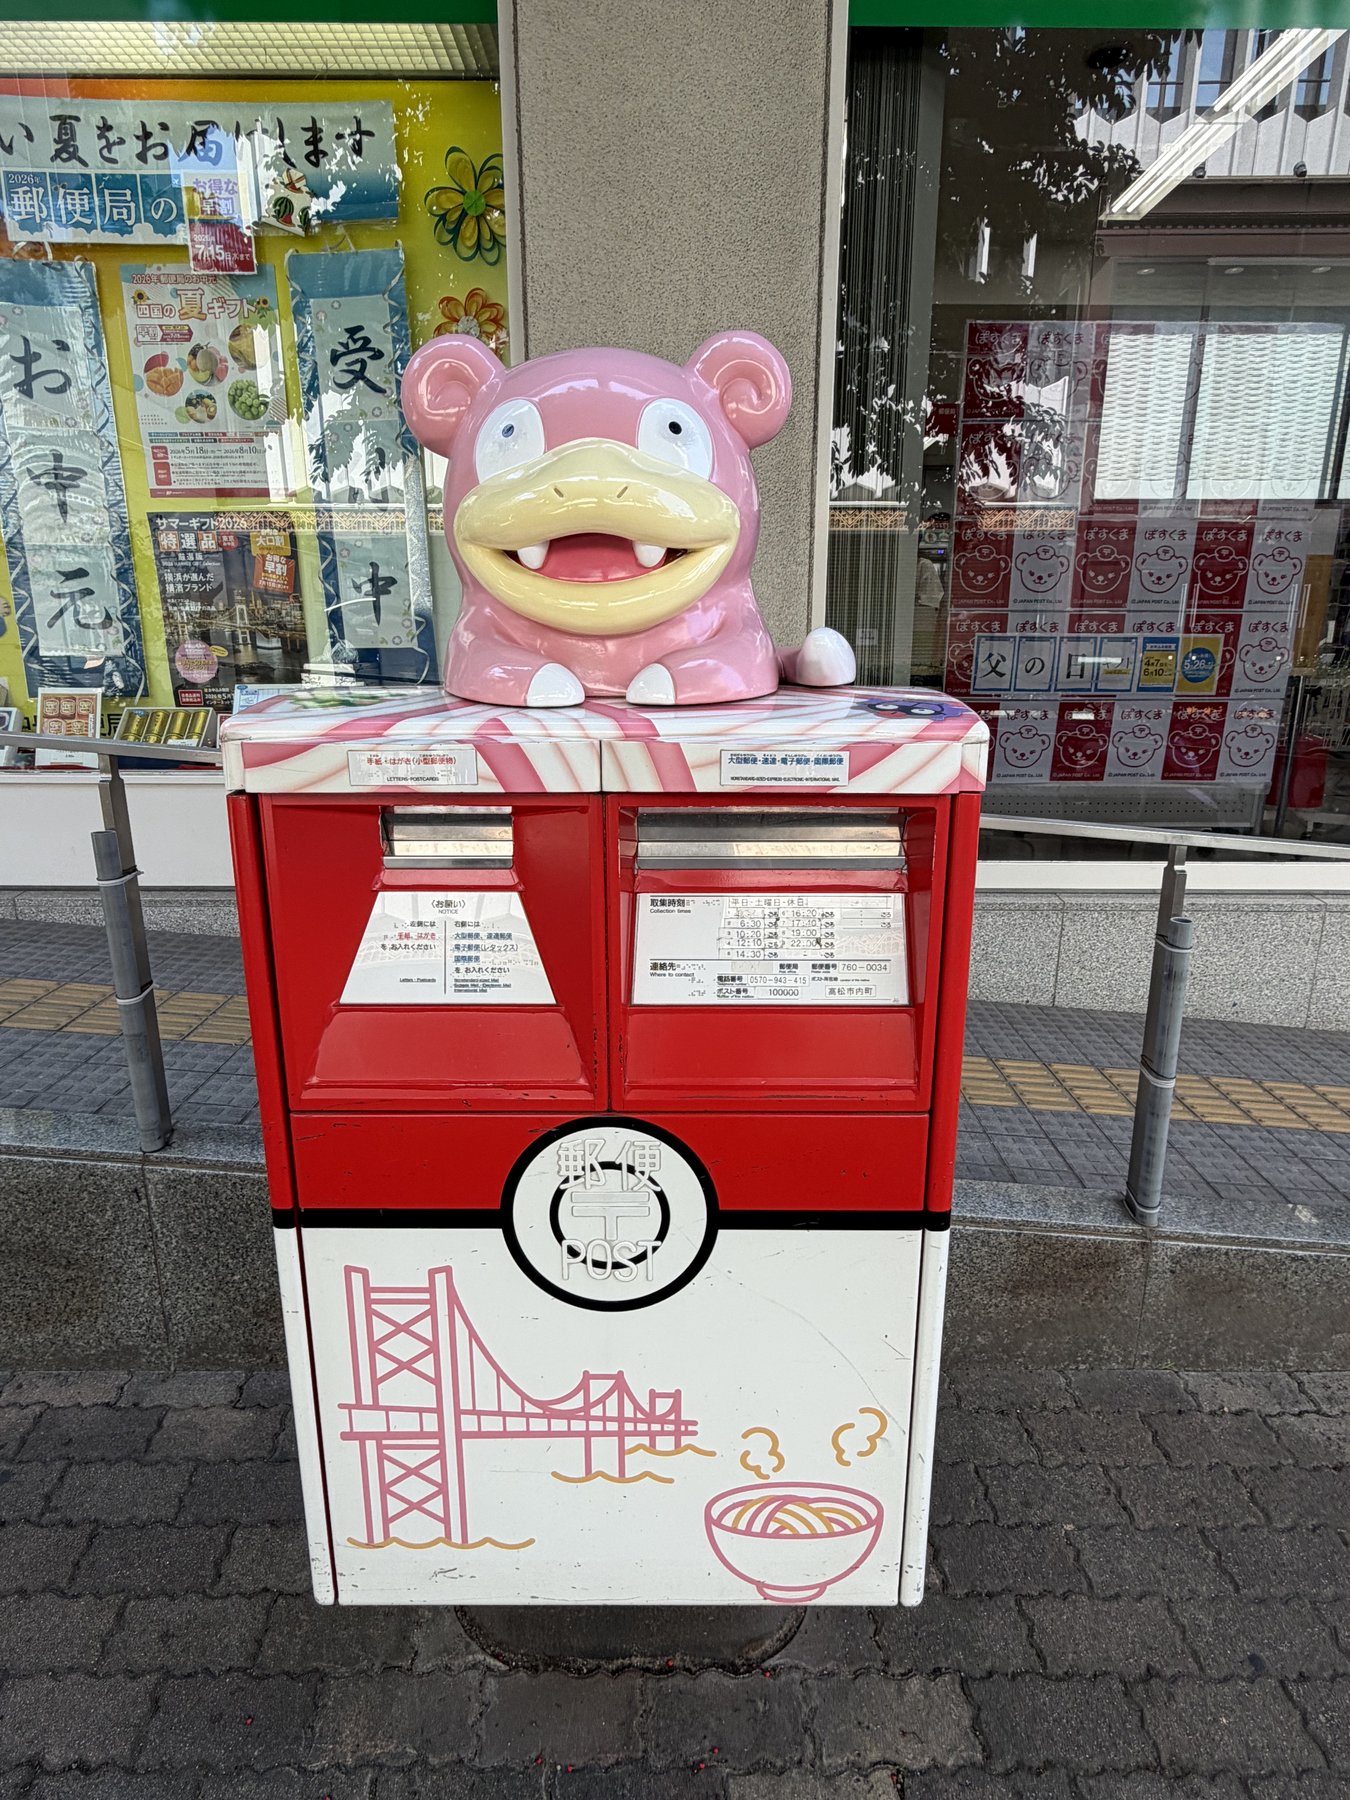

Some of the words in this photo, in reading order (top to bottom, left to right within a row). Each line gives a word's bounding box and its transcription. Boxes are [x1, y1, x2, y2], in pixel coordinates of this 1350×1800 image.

[10, 186, 177, 226] 郵便局の
[137, 287, 257, 321] 四国の夏ギフト
[329, 325, 399, 626] 受中
[10, 335, 113, 629] お中元
[156, 517, 247, 530] サマーギフト2026
[160, 532, 217, 549] 特選品
[1083, 528, 1128, 541] ぽすくま
[1145, 529, 1187, 541] ぽすくま
[1202, 528, 1248, 541] ぽすくま
[956, 621, 1001, 633] ぽすくま
[1015, 620, 1059, 633] ぽすくま
[1075, 620, 1119, 633] ぽすくま
[1133, 620, 1175, 633] ぽすくま
[1190, 621, 1235, 633] ぽすくま
[1248, 620, 1289, 633] ぽすくま
[979, 652, 1087, 679] 父の日
[1121, 709, 1163, 720] ぽすくま
[650, 898, 685, 907] 取集時刻
[792, 909, 817, 917] 16:20
[740, 920, 761, 928] 6:30
[736, 930, 762, 939] 10:20
[791, 929, 817, 937] 19:00
[737, 938, 762, 947] 12:10
[736, 950, 762, 958] 14:30
[464, 966, 510, 974] お入れください
[650, 962, 677, 971] 連絡先
[841, 963, 888, 972] 760-0034
[749, 976, 807, 984] 0570-943-415
[768, 988, 799, 997] 100000
[828, 987, 873, 995] 高松市内町
[557, 1139, 662, 1192] 郵便
[561, 1239, 662, 1282] POST
